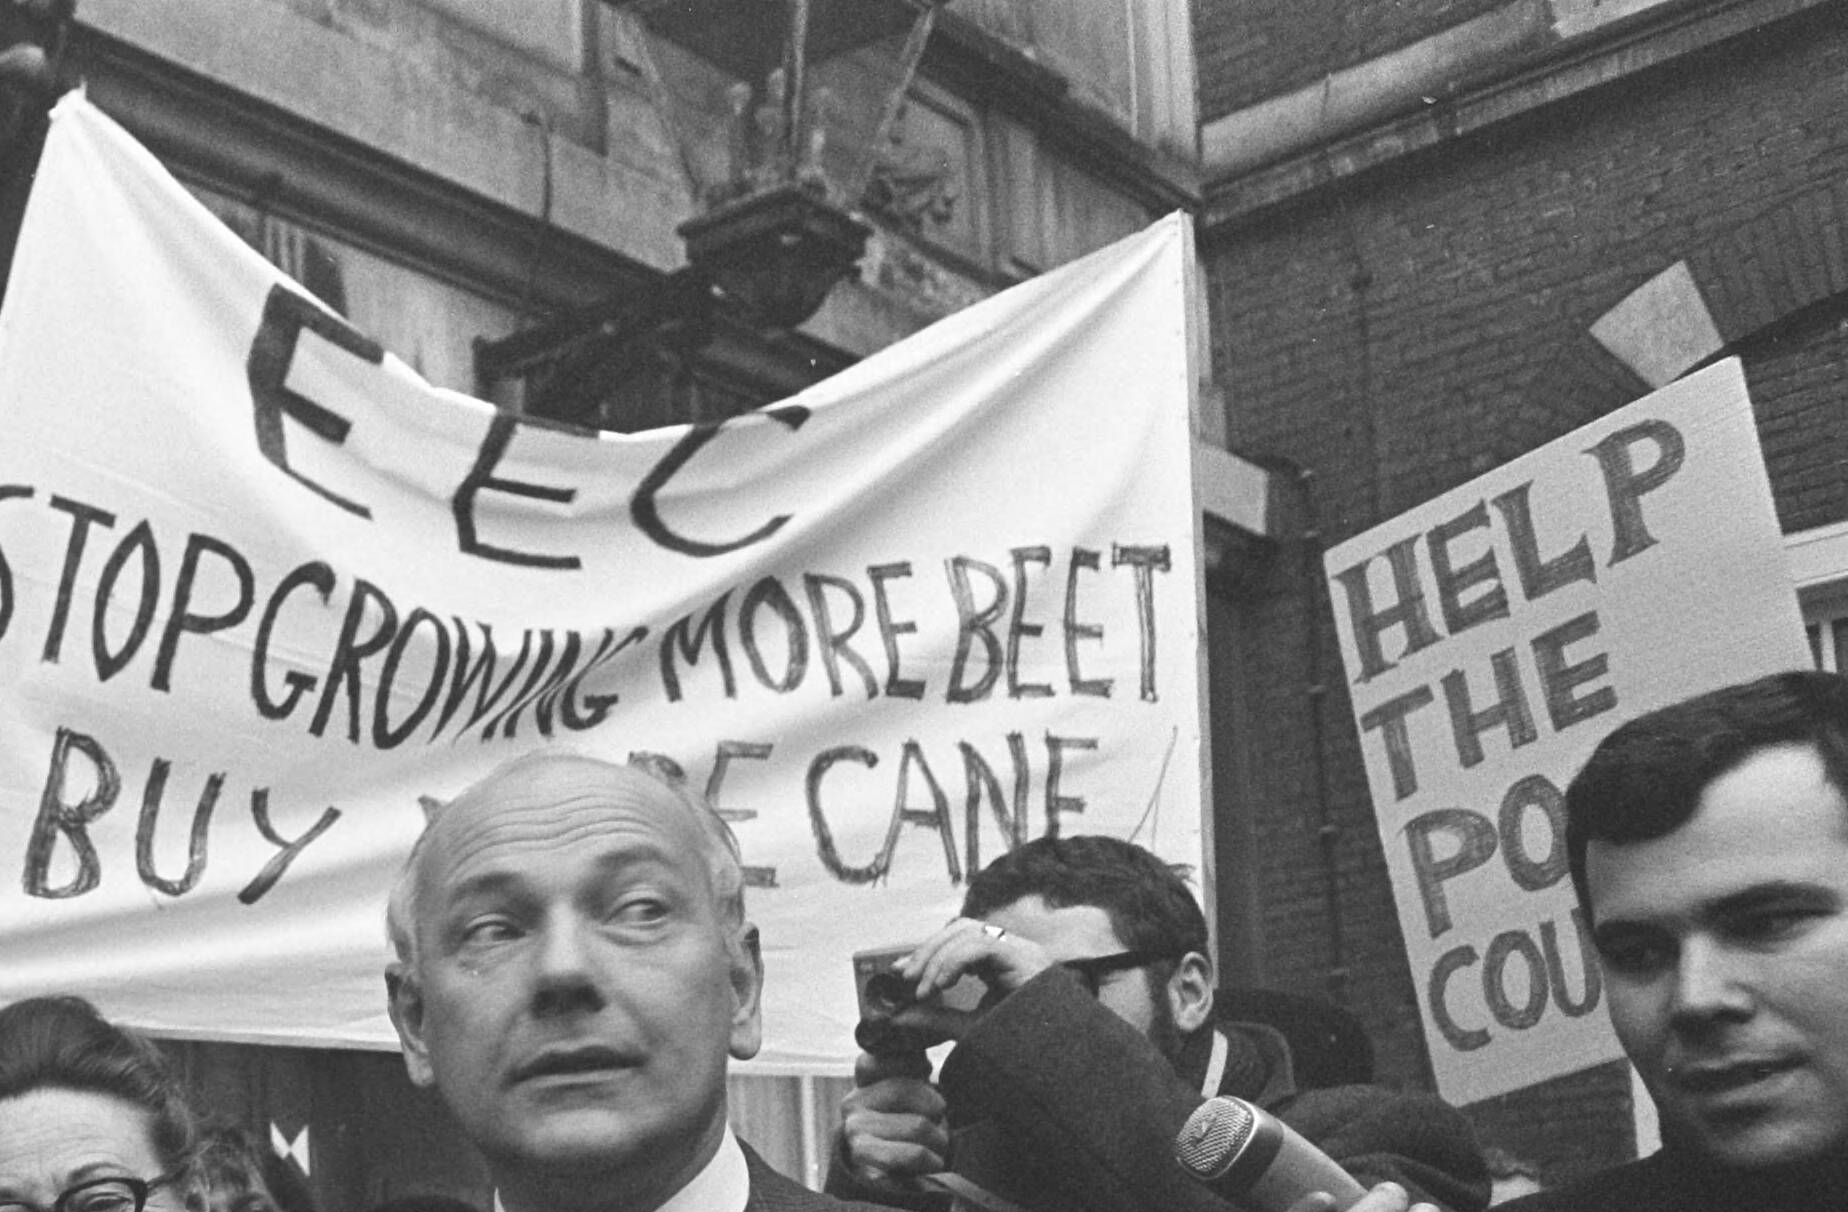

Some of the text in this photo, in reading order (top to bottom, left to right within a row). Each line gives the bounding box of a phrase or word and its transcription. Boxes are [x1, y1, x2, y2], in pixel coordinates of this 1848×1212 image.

[245, 282, 812, 569] EEC
[250, 560, 650, 750] GROWING
[659, 560, 926, 704] MORE
[945, 543, 1171, 704] BEET
[1334, 418, 1687, 684] HELP
[1360, 610, 1619, 801] THE
[22, 727, 342, 905] BUY
[804, 731, 1100, 886] CANE
